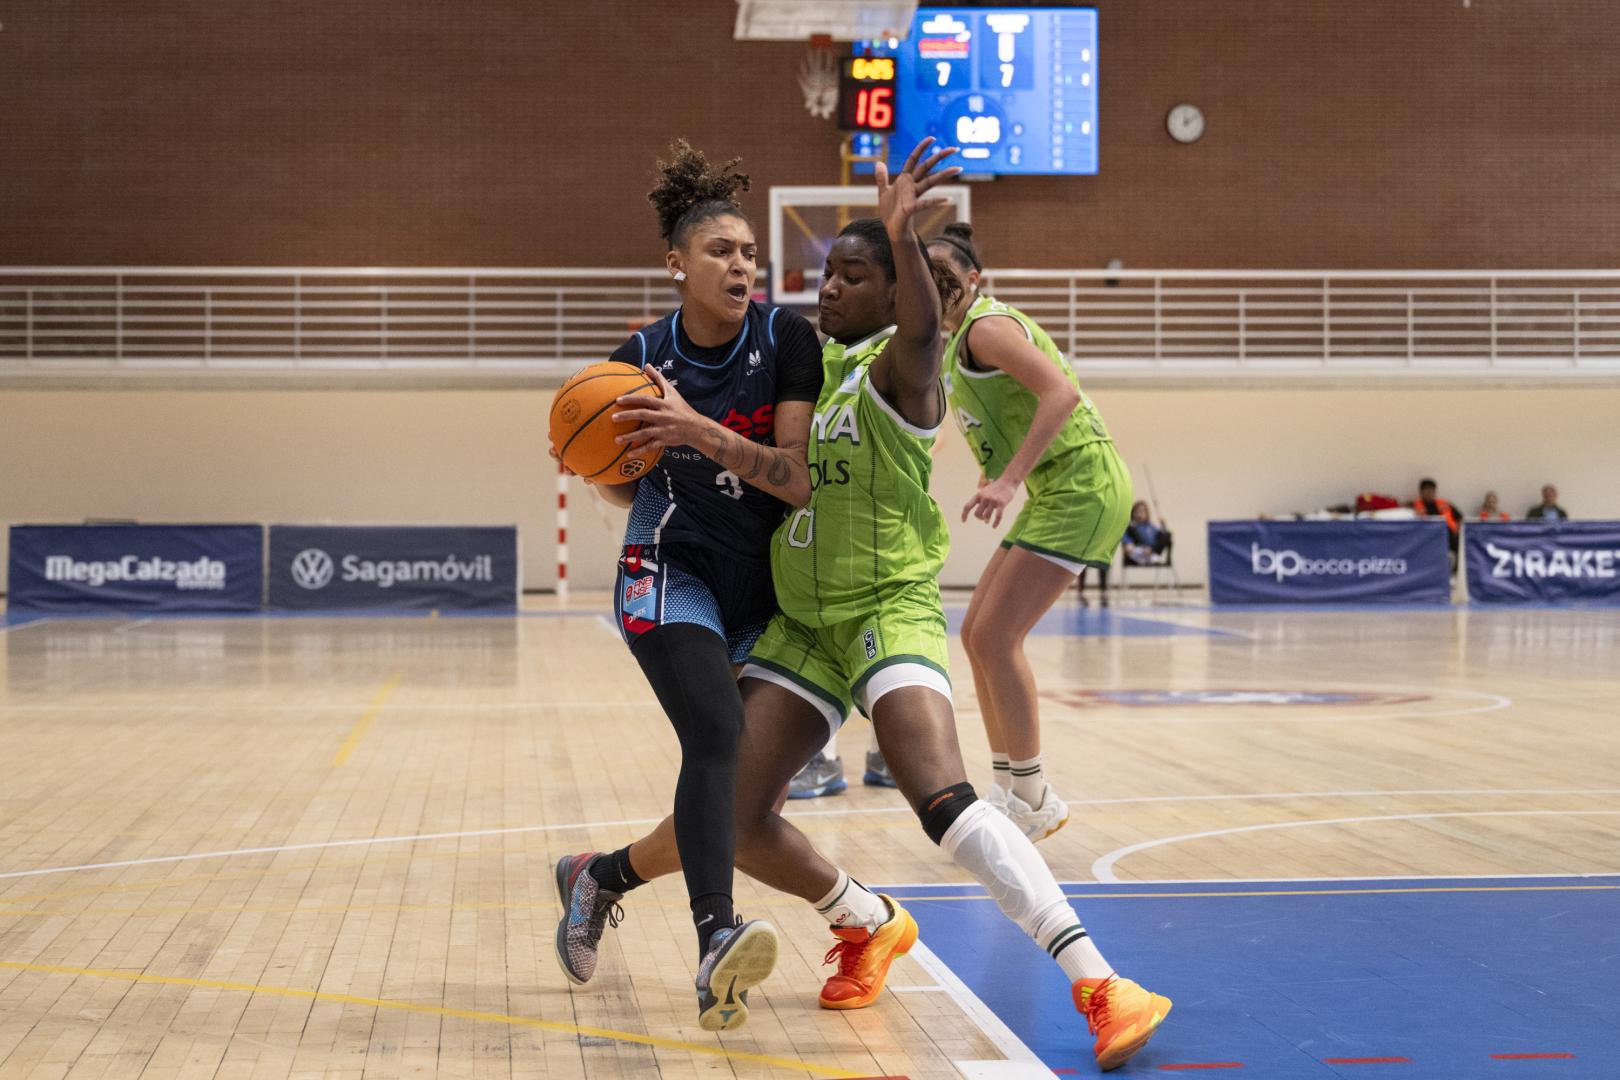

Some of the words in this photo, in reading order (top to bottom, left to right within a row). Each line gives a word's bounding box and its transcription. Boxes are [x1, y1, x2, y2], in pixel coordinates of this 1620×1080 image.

[936, 61, 951, 87] 7
[1000, 63, 1014, 88] 7
[856, 87, 893, 128] 16
[810, 403, 861, 446] YA
[664, 449, 709, 461] CONS
[715, 470, 744, 500] 3
[808, 459, 851, 492] OLS
[45, 555, 227, 586] MegaCalzado
[341, 554, 493, 588] Sagamóvil
[1251, 541, 1301, 583] bp
